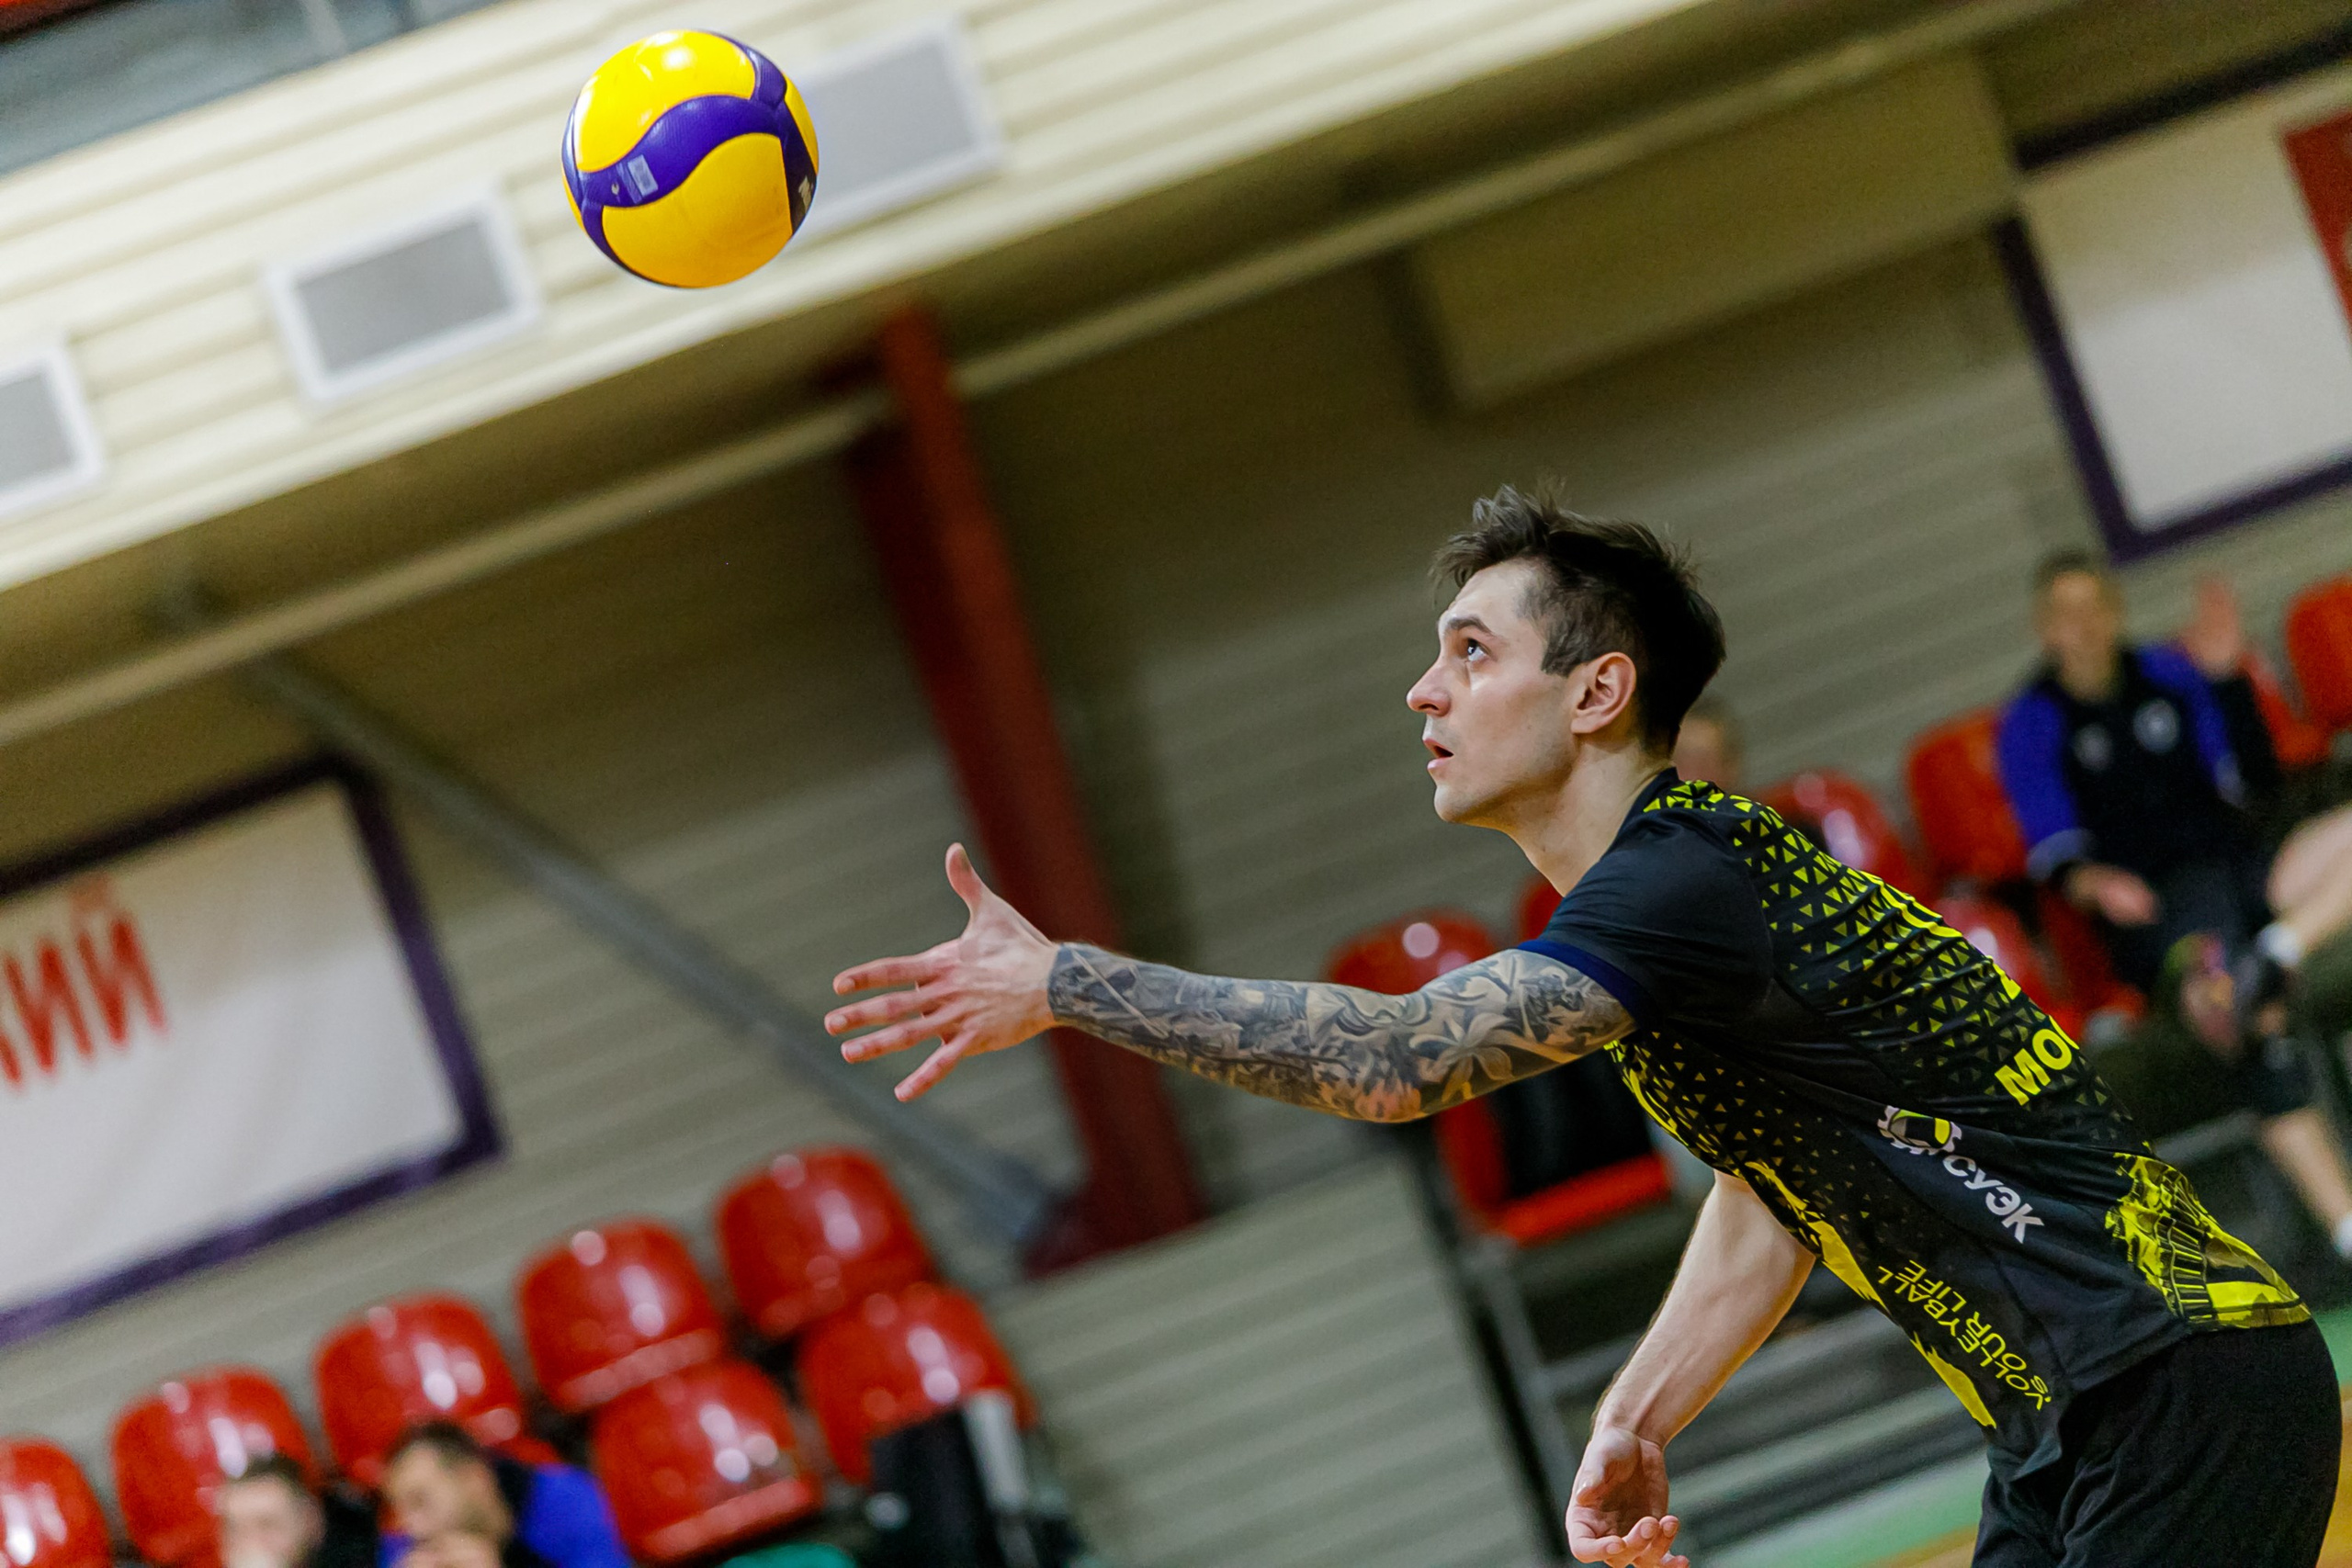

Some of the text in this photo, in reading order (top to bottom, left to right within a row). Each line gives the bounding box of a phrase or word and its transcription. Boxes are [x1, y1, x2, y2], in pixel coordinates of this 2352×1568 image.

[0, 874, 169, 1086] ИЙ
[1942, 1155, 2044, 1244] СУЭК
[1898, 1259, 1967, 1313] LIFE
[1878, 1266, 2042, 1411] VOLLEYBALL
[1966, 1312, 2027, 1371] OUR
